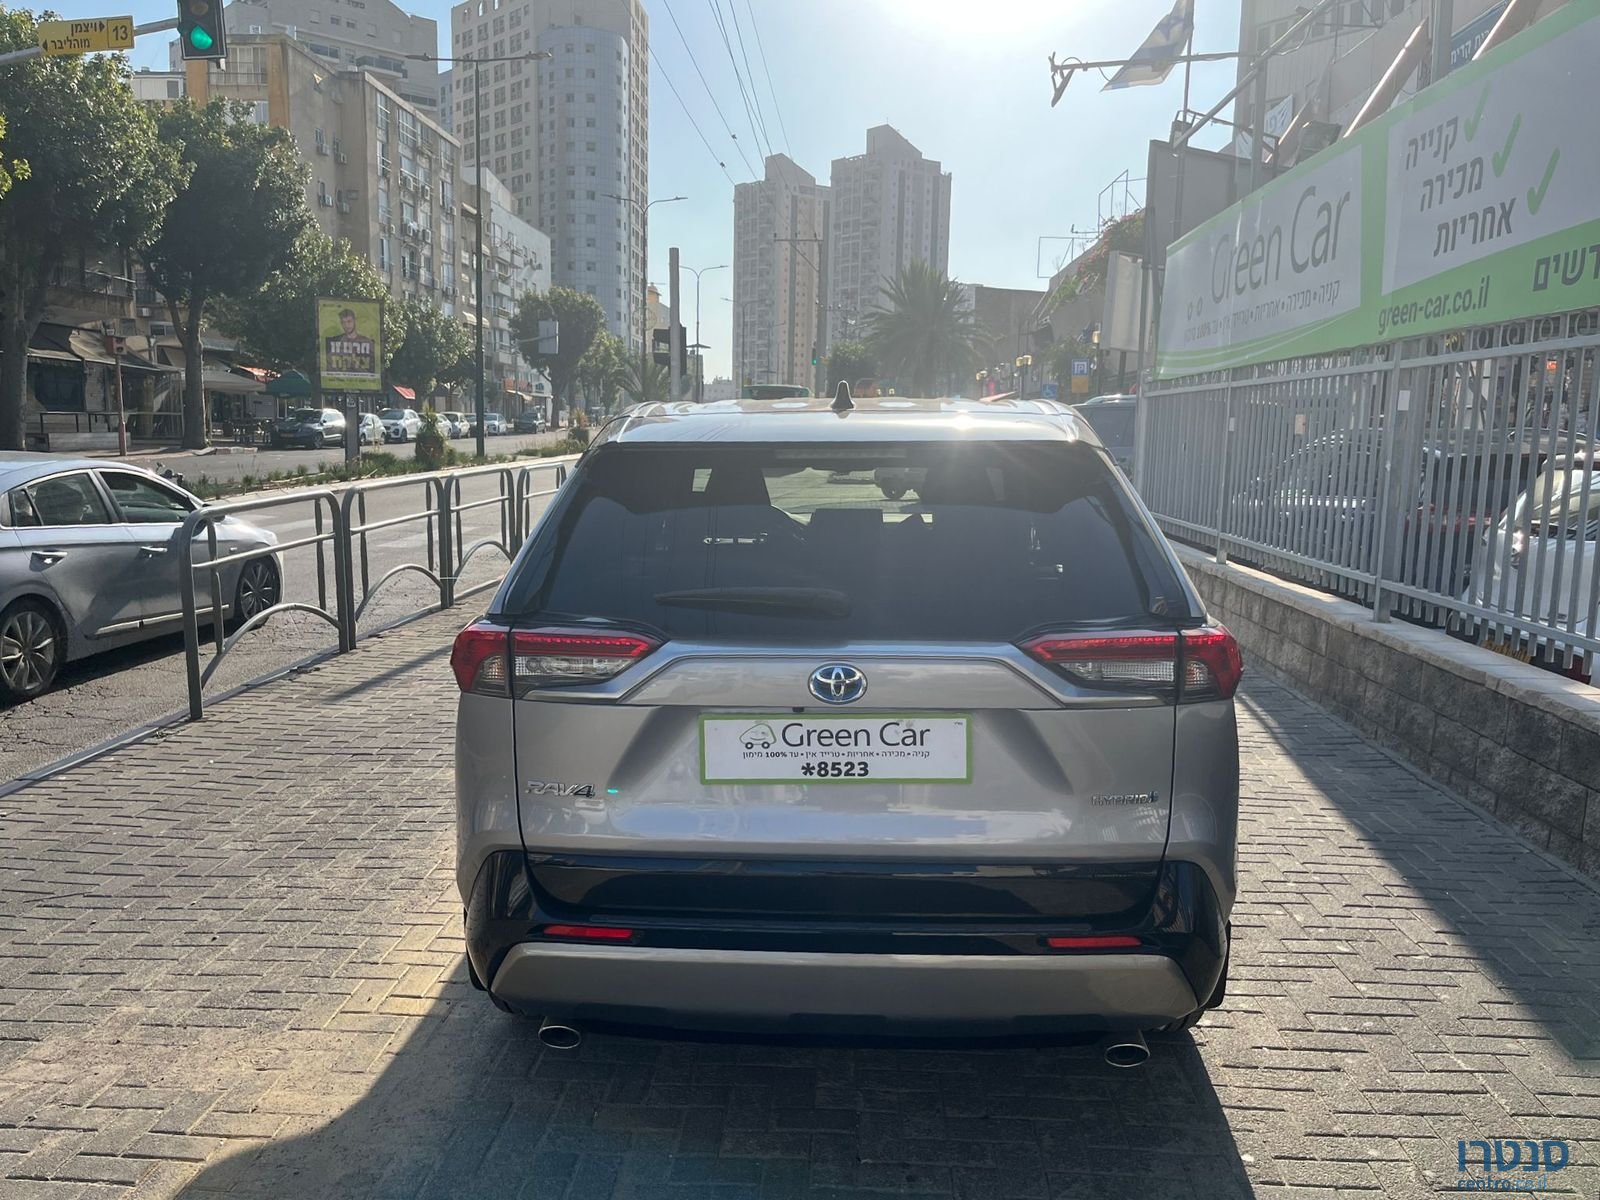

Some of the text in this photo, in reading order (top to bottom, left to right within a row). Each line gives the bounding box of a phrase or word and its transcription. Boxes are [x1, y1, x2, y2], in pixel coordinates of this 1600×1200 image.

[71, 21, 97, 37] ויצמן
[113, 25, 128, 41] 13
[50, 36, 90, 50] מוהליבר
[1405, 116, 1459, 170] קנייה
[1420, 156, 1484, 212] מכירה
[1433, 198, 1516, 257] אחריות
[1211, 185, 1350, 304] Green Car
[1286, 289, 1312, 313] מכירה
[1319, 279, 1341, 308] קניה
[1378, 274, 1490, 335] green-car.co.il
[781, 722, 930, 747] Green Car
[742, 750, 930, 759] קניה מכירה אחריות טרייד אין עד 100% מימון
[525, 780, 595, 798] RAV4
